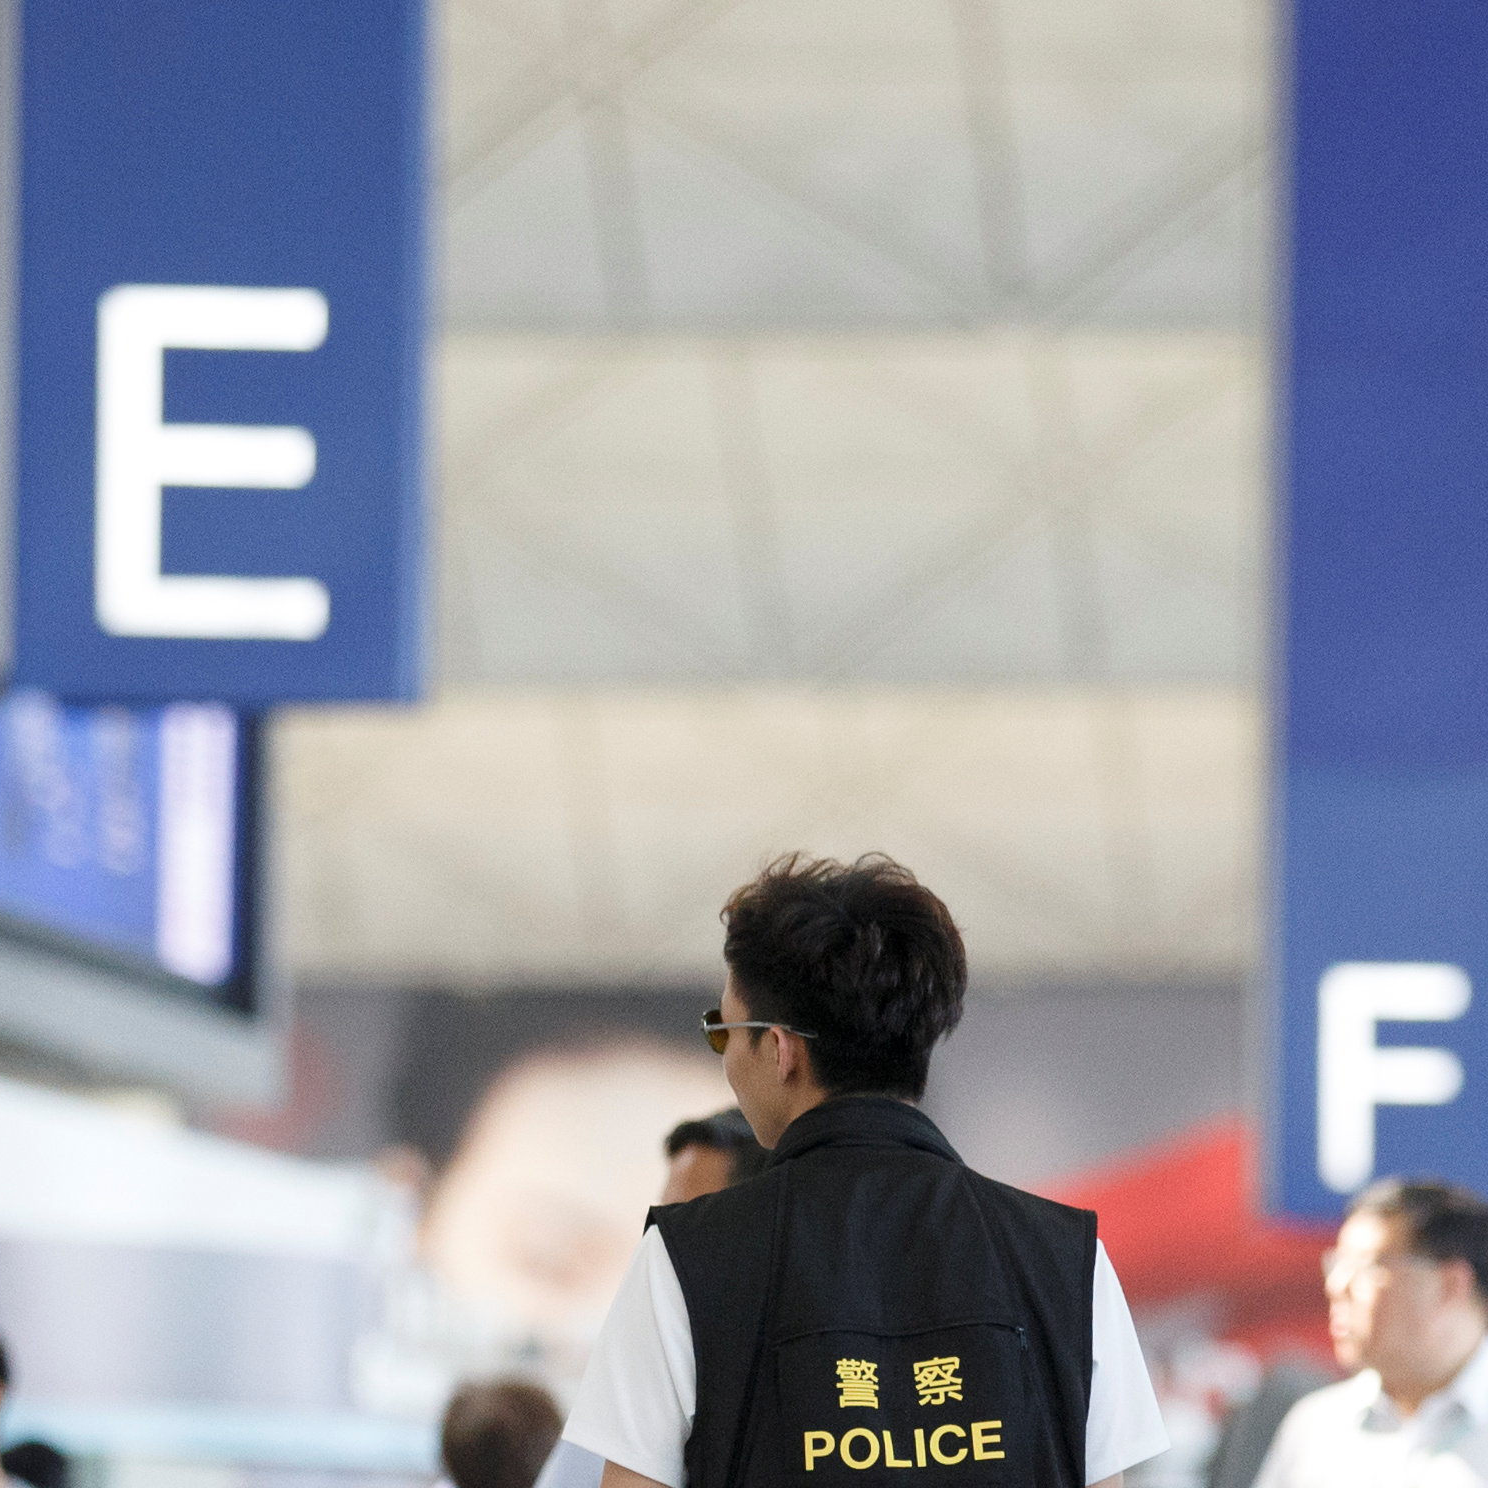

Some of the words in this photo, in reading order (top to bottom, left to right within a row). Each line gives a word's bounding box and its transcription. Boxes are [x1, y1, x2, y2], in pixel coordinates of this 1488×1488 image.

[95, 283, 331, 641] E
[1316, 961, 1473, 1195] F
[803, 1420, 1006, 1471] POLICE
[835, 1356, 964, 1410] 警察
